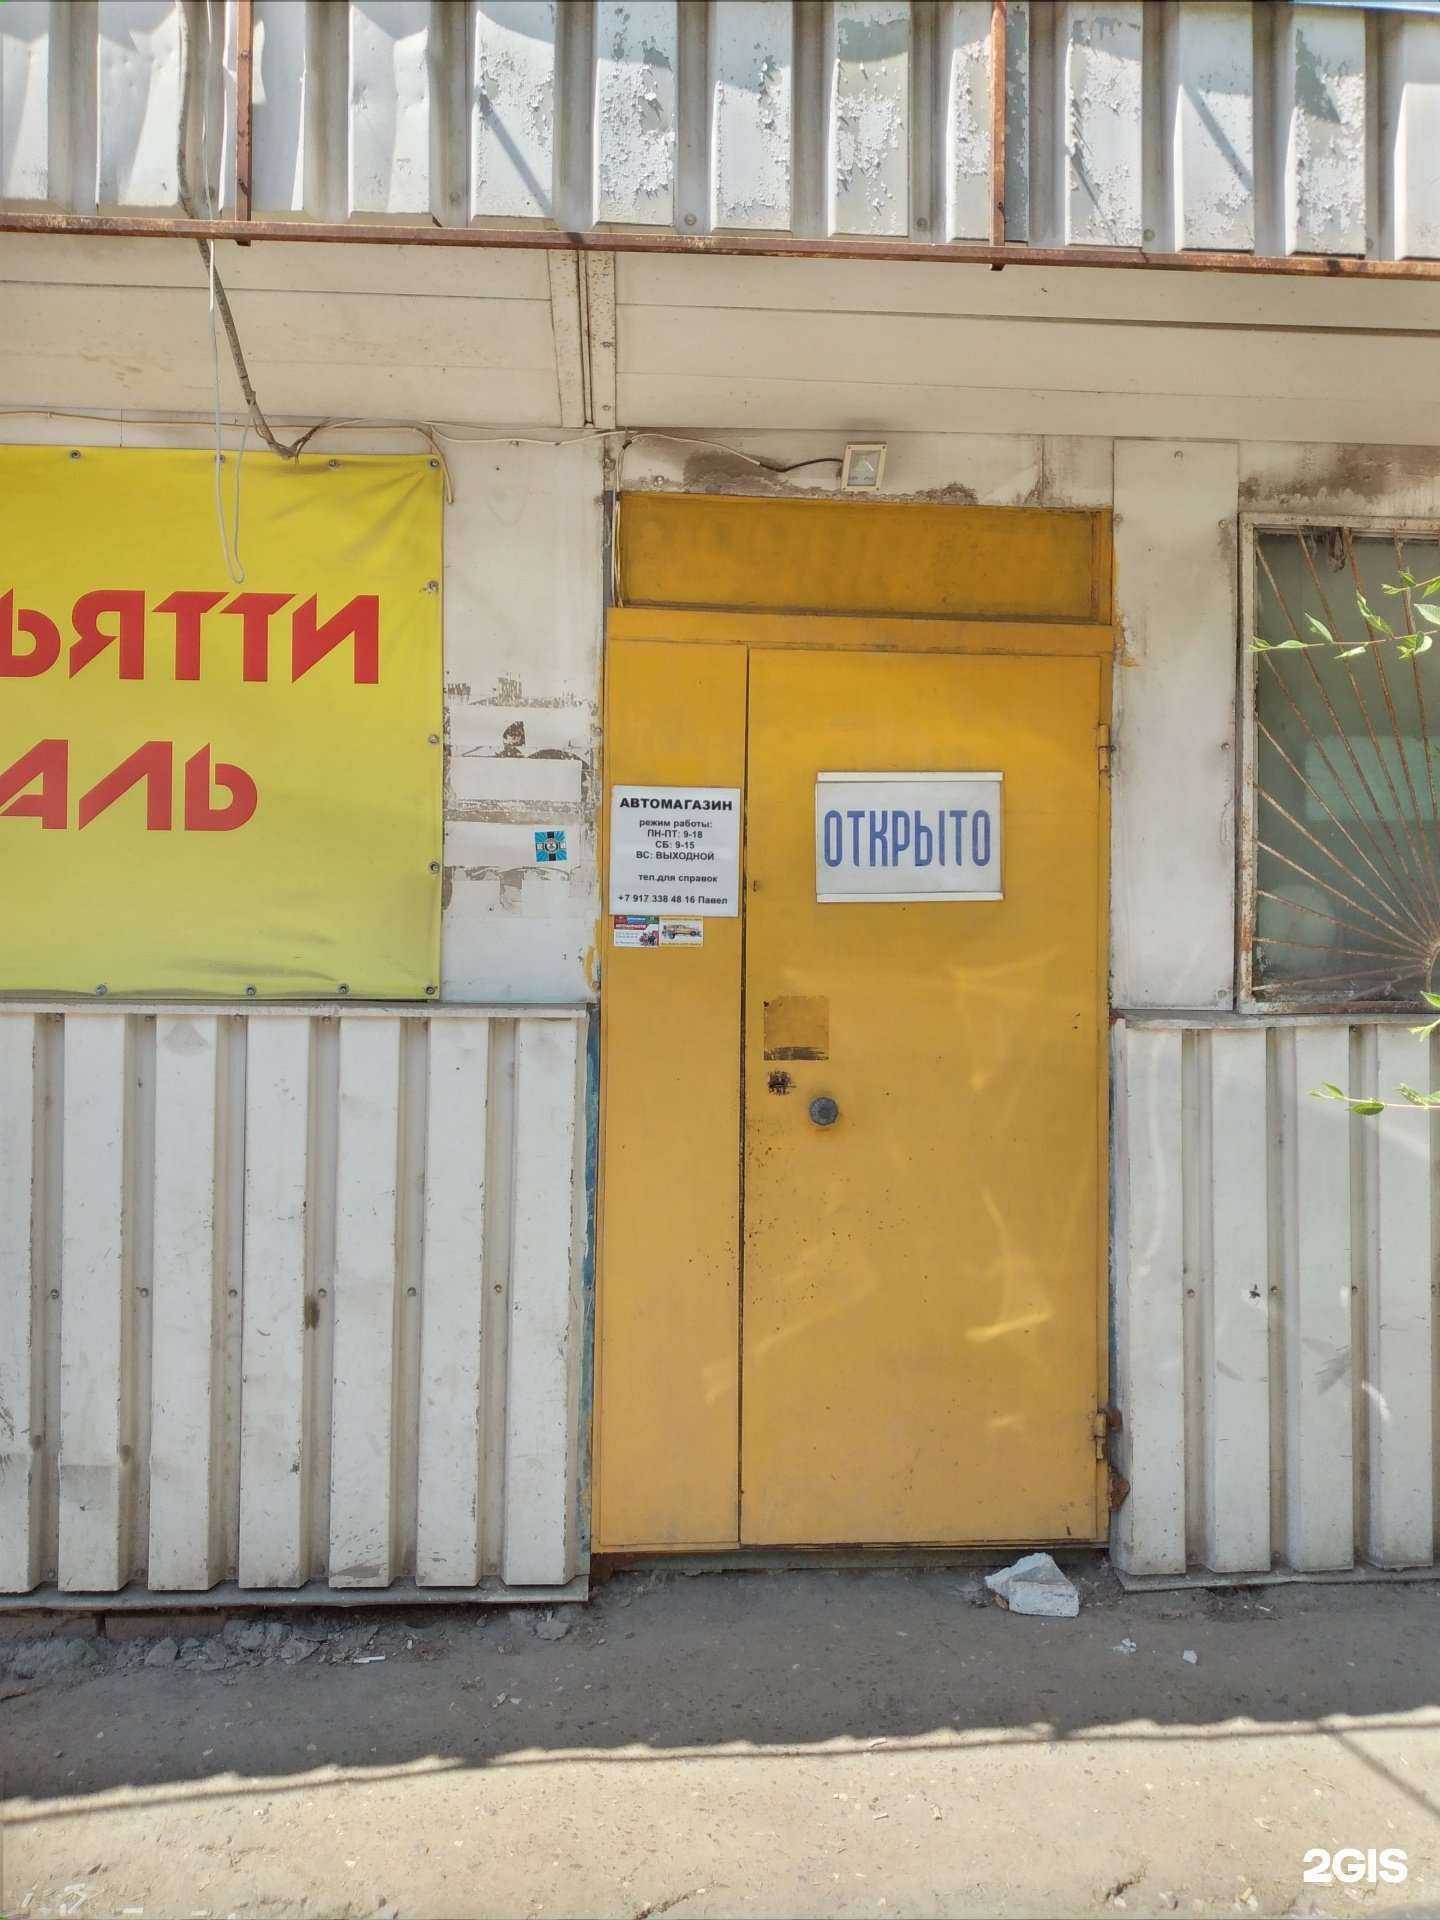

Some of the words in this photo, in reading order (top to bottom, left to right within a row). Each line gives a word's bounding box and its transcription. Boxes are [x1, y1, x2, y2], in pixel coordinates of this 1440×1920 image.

[0, 587, 380, 684] ЬЯТТИ
[0, 739, 258, 831] АЛЬ
[619, 797, 733, 811] АВТОМАГАЗИН
[639, 820, 671, 828] режим
[673, 820, 713, 828] работы:
[647, 829, 681, 838] ПН-ПТ:
[683, 830, 703, 839] 9-18
[824, 809, 991, 868] ОТКРЫТО
[655, 840, 672, 849] СБ:
[675, 841, 695, 849] 9-15
[636, 850, 653, 859] ВС:
[656, 851, 714, 861] ВЫХОДНОЙ
[678, 875, 718, 883] справок
[618, 894, 630, 902] +7
[632, 894, 649, 903] 917
[652, 895, 669, 903] 338
[685, 895, 695, 904] 16
[698, 896, 728, 904] Павел
